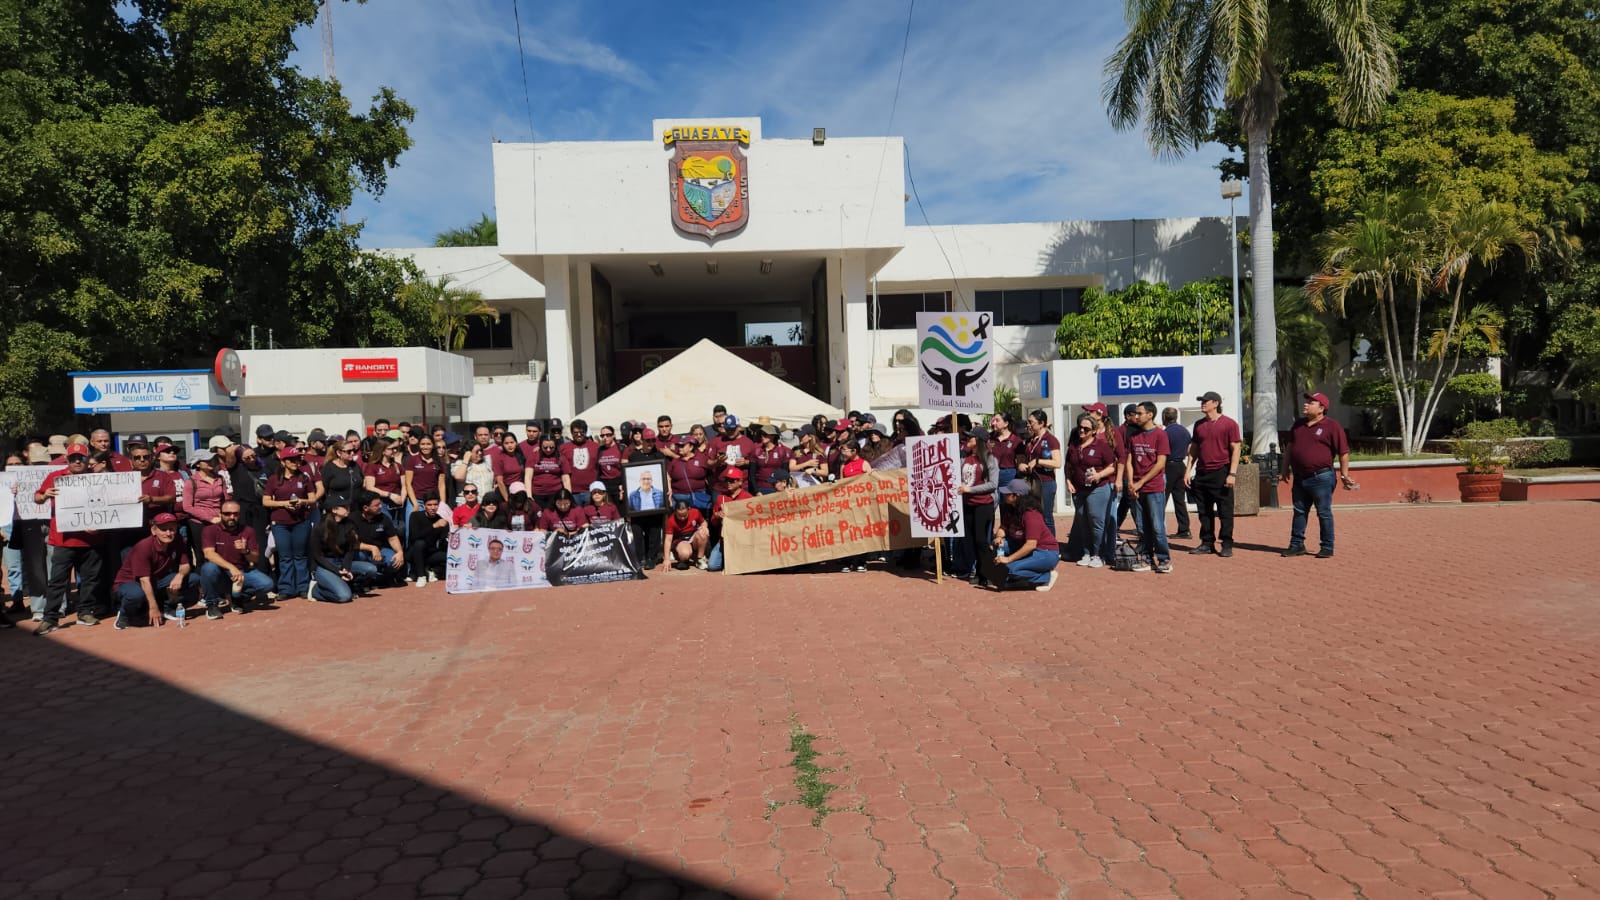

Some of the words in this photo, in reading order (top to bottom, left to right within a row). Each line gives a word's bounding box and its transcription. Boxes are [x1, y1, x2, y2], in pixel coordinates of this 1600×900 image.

[672, 128, 742, 139] GUASAVE
[104, 381, 164, 395] JUMAPAG
[1118, 373, 1166, 389] BBVA
[928, 398, 953, 407] Unidad
[955, 398, 983, 409] Sinaloa
[922, 437, 951, 468] IPN
[746, 501, 763, 516] Se
[813, 491, 829, 503] un
[878, 479, 894, 490] un
[70, 509, 121, 527] JUSTA
[744, 518, 757, 529] un
[799, 509, 812, 519] un
[856, 496, 872, 507] un
[875, 490, 910, 505] amig
[770, 531, 799, 556] Nos
[801, 523, 835, 549] falta
